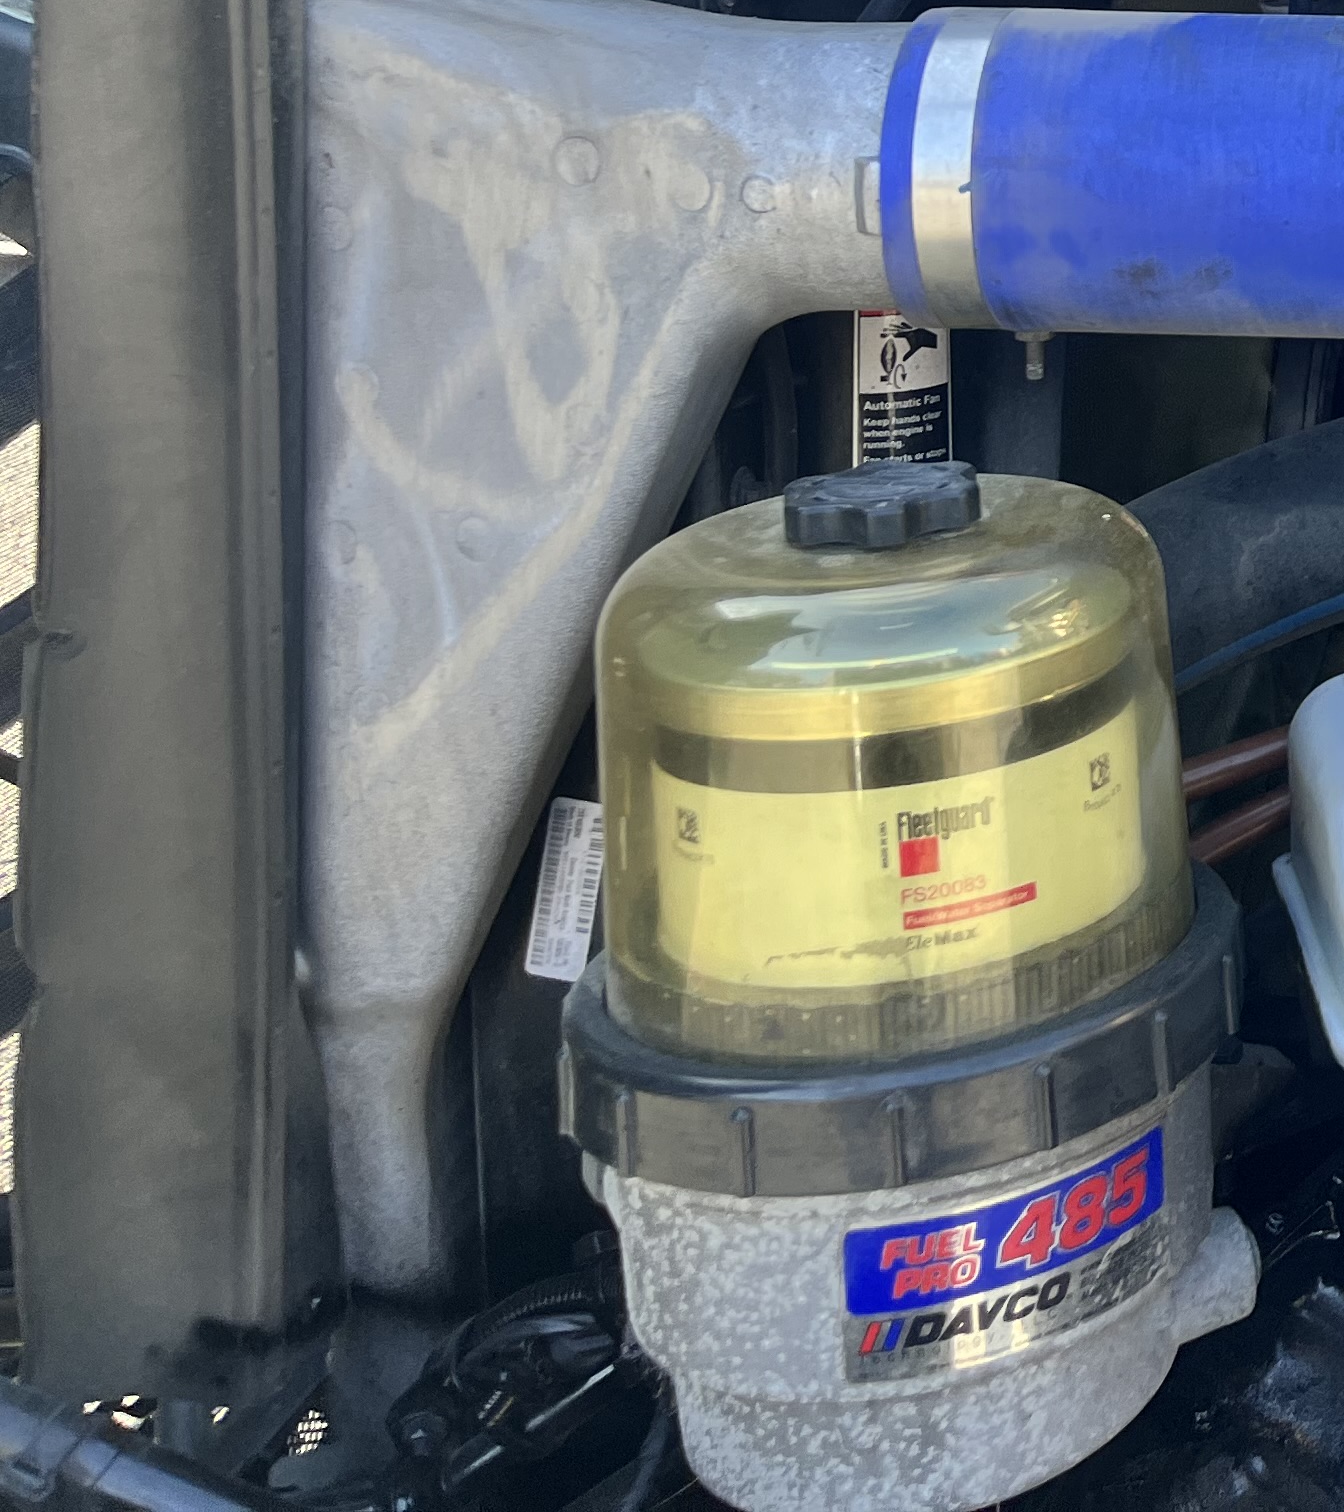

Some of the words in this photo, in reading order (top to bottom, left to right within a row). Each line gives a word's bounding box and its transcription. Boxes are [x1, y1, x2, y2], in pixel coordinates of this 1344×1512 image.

[863, 396, 922, 410] Automatic
[923, 394, 941, 405] Fan
[863, 417, 890, 427] Keep
[891, 414, 921, 425] hands
[863, 429, 891, 438] when
[896, 797, 992, 842] Fleetguard
[900, 874, 987, 905] FS20083
[996, 1146, 1151, 1271] 485
[879, 1222, 985, 1272] FUEL
[892, 1254, 982, 1301] PRO
[903, 1271, 1072, 1349] DAVCO
